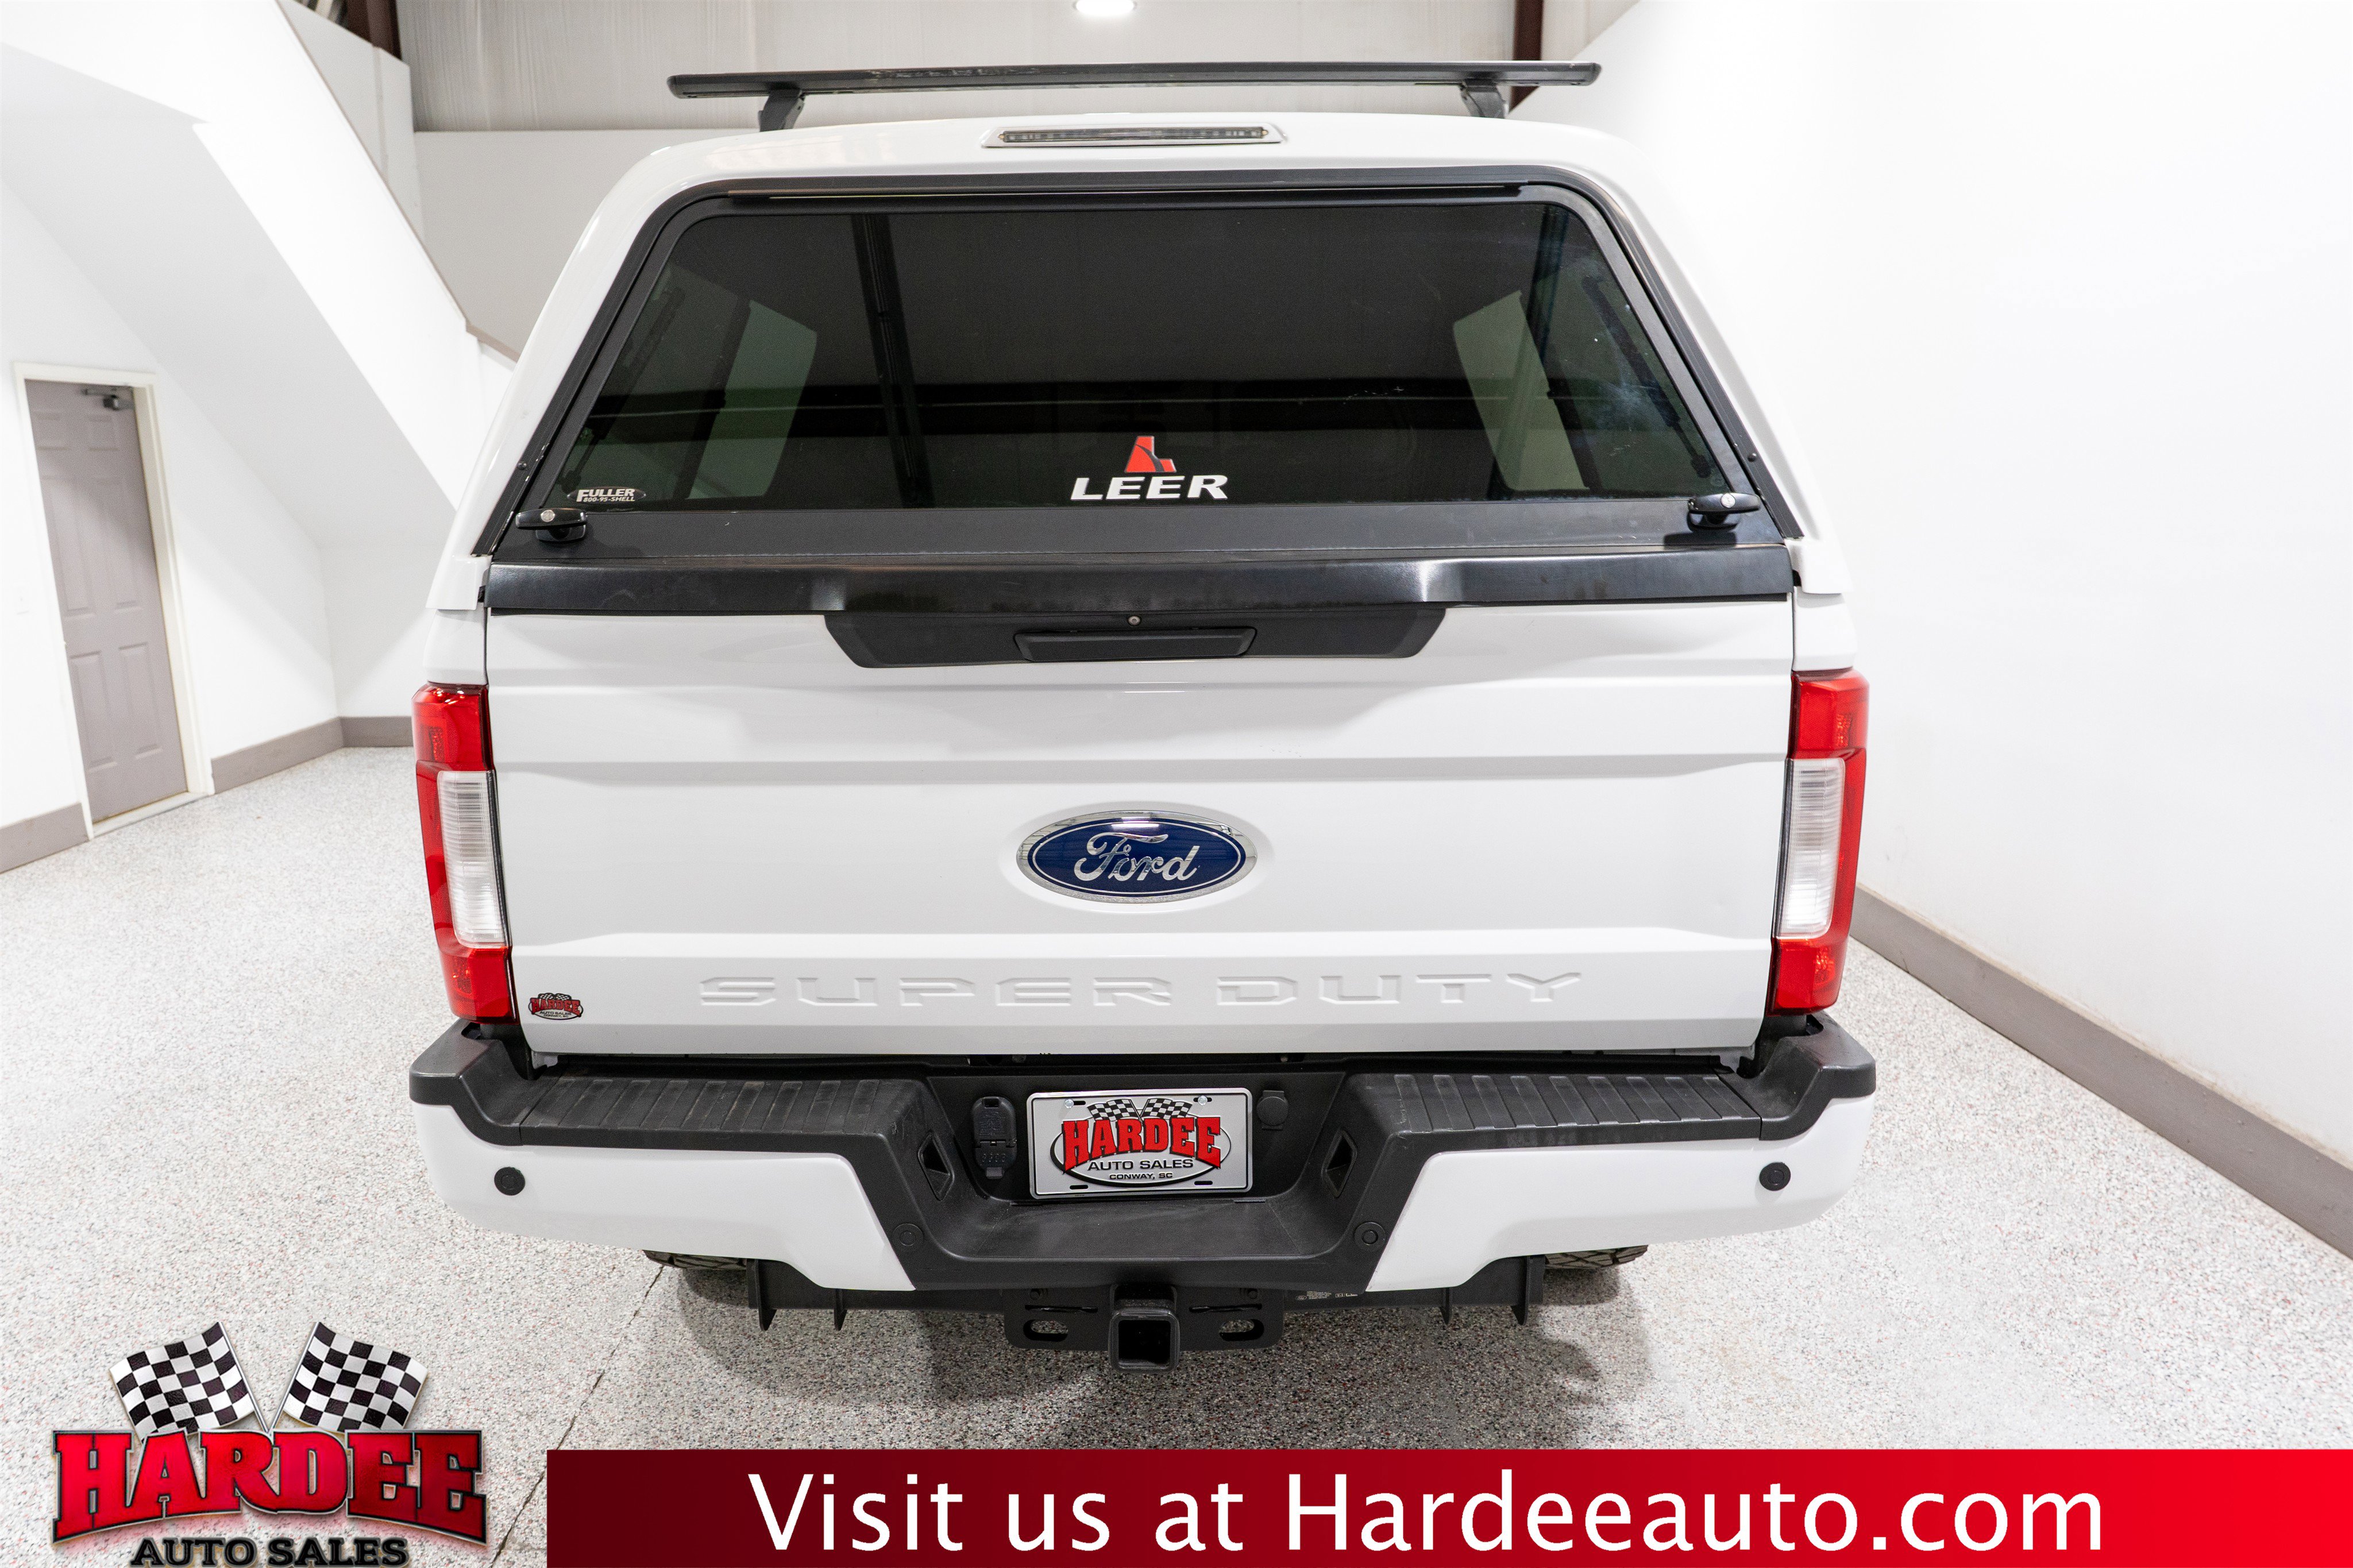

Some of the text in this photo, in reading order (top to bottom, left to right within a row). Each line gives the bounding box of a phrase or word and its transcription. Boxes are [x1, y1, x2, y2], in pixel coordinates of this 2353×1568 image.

[576, 488, 635, 502] FULLER
[1070, 474, 1228, 501] LEER
[1074, 832, 1201, 882] Ford
[700, 972, 1582, 1006] SUPER DUTY
[530, 998, 581, 1017] HARDEE
[1062, 1117, 1221, 1174] HARDEE
[1087, 1158, 1194, 1171] AUTO SALES
